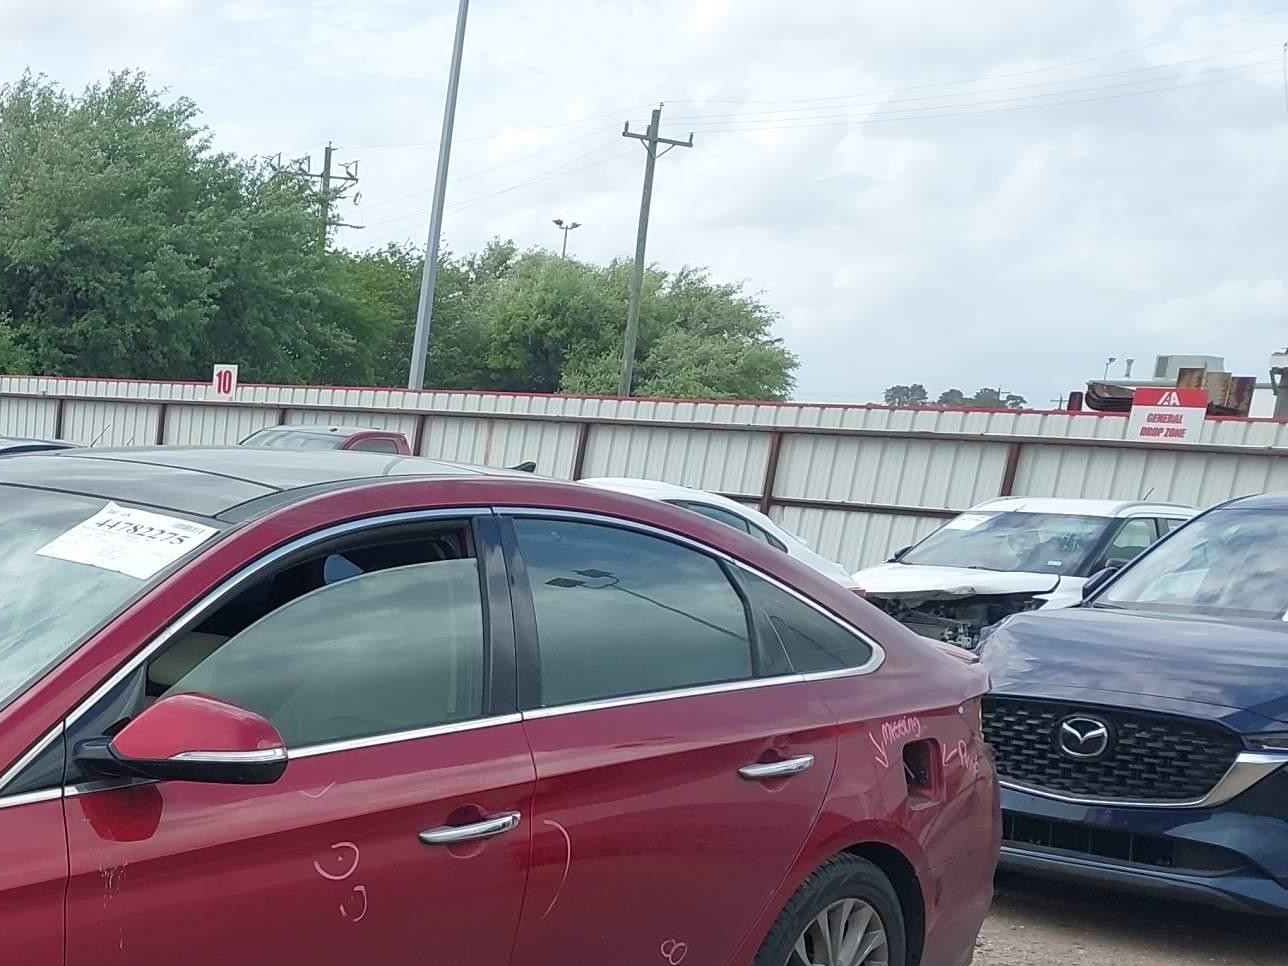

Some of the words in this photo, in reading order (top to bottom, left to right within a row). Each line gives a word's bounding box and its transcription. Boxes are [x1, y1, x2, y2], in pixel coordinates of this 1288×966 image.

[216, 370, 232, 394] 10
[1146, 412, 1183, 424] GENERAL
[1140, 426, 1164, 437] DROP
[1164, 427, 1187, 438] ZONE
[96, 519, 191, 544] 44782275
